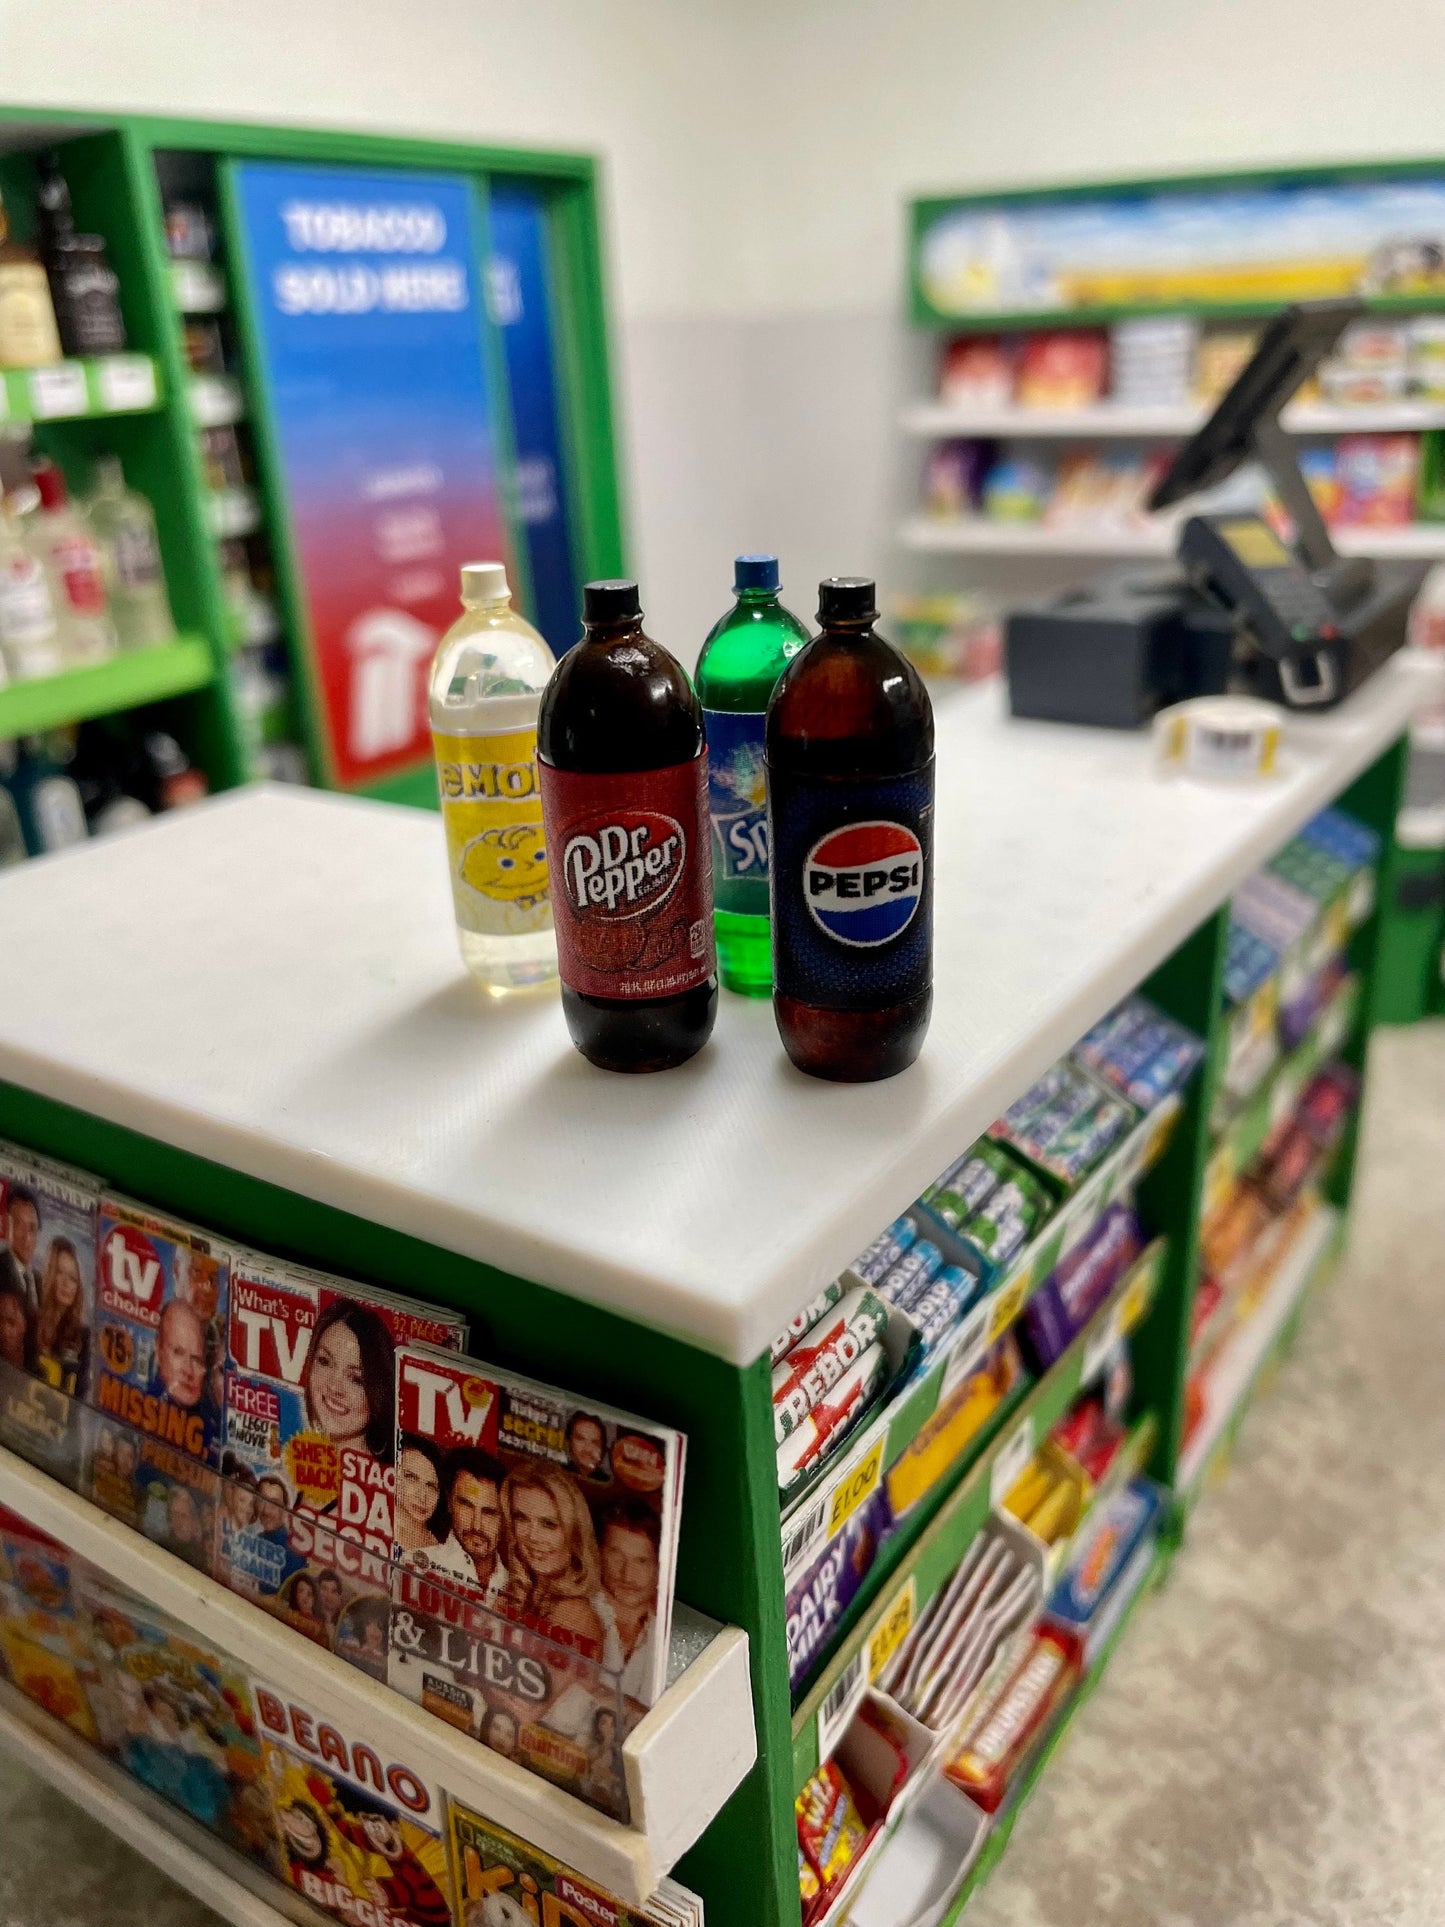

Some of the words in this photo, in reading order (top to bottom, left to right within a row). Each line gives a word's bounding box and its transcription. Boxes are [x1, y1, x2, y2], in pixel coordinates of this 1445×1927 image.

[599, 825, 648, 869] Dr
[565, 835, 678, 909] Pepper
[809, 862, 919, 899] PEPSI
[107, 1232, 160, 1300] tv
[103, 1290, 161, 1326] choice
[238, 1286, 290, 1320] What's
[295, 1308, 315, 1328] on
[238, 1307, 313, 1385] TV
[234, 1384, 280, 1420] FREE
[403, 1363, 494, 1448] TV
[292, 1438, 338, 1467] SHE'S
[295, 1462, 338, 1490] BACK
[786, 1535, 848, 1649] DAIRY
[393, 1611, 428, 1655] &
[255, 1686, 431, 1814] BEANO
[561, 1879, 620, 1927] Poster
